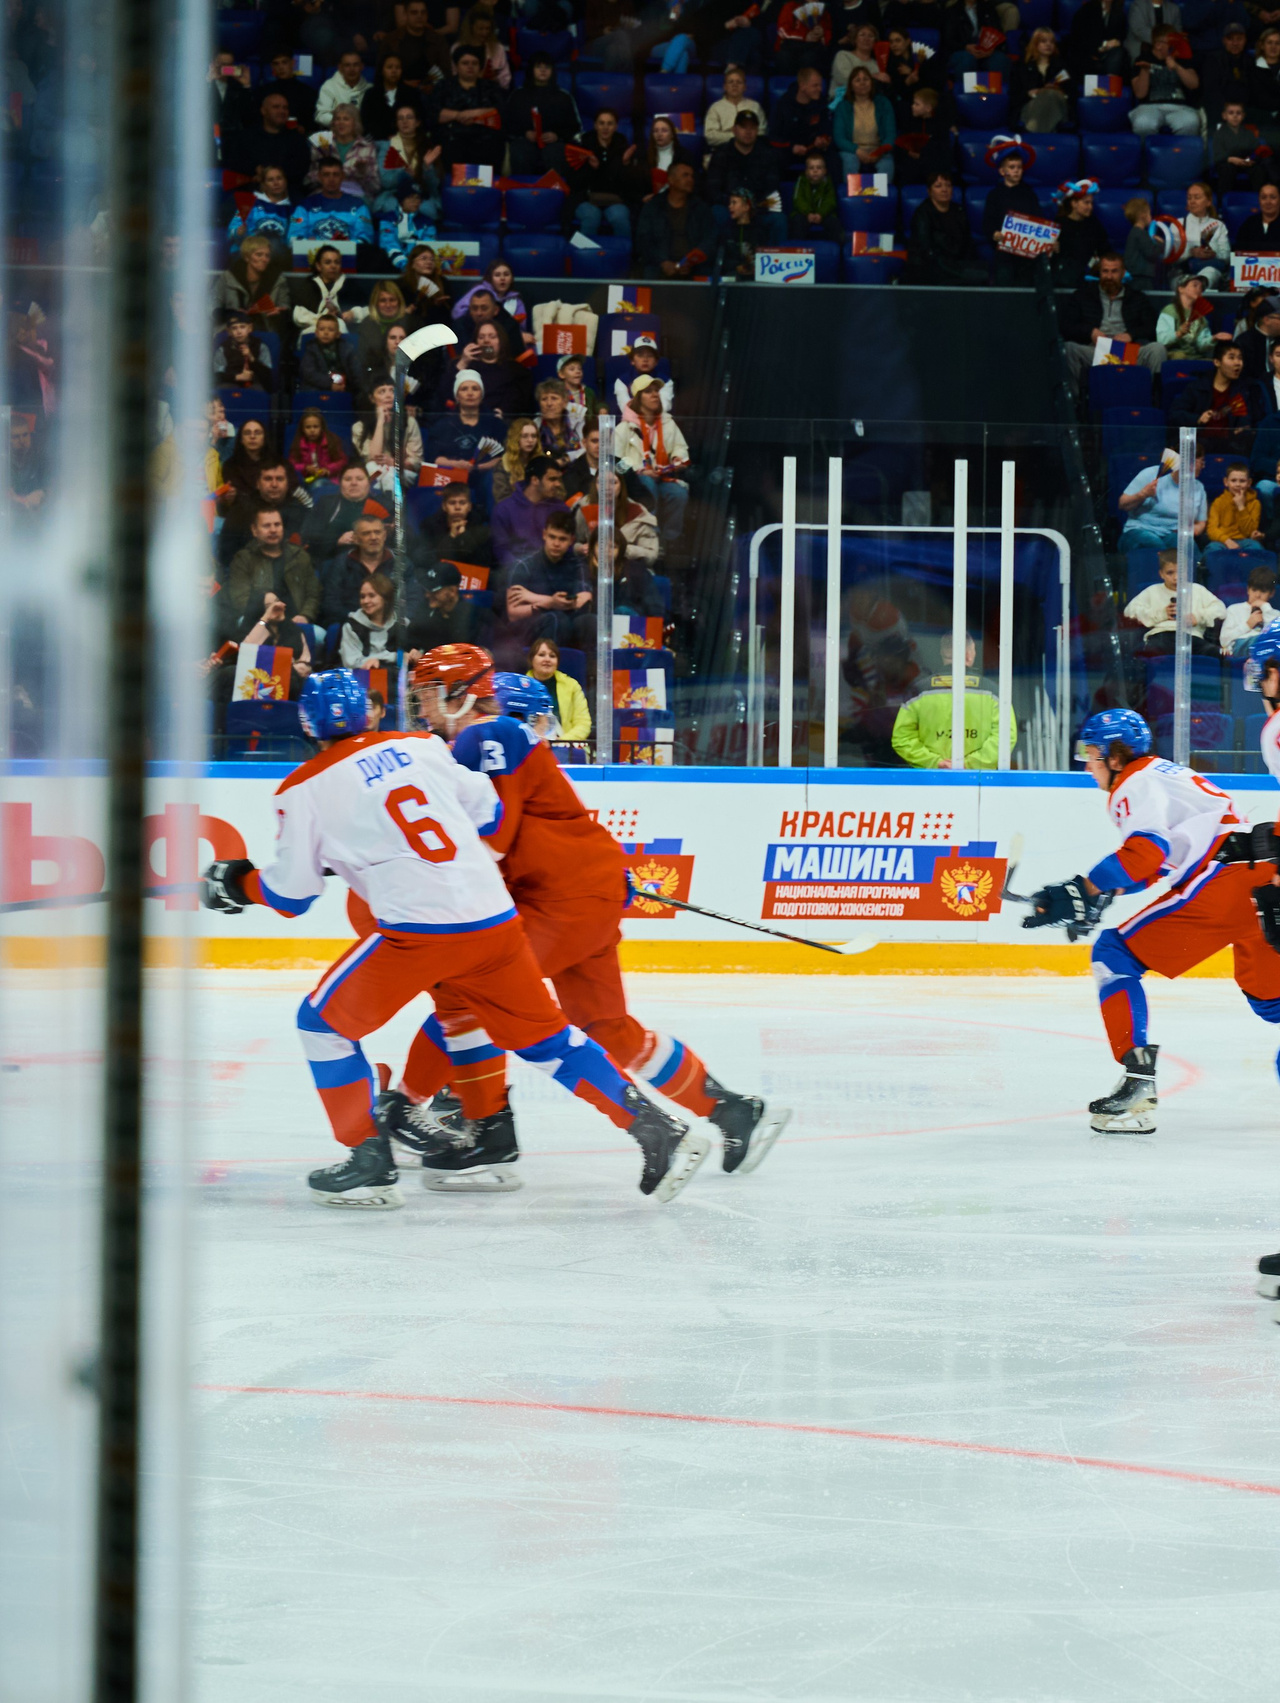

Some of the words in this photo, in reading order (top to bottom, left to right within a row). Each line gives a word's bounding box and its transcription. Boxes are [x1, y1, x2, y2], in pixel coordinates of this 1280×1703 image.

[355, 746, 414, 788] ДИЛЬ
[384, 783, 457, 864] 6
[779, 811, 914, 839] КРАСНАЯ
[772, 847, 915, 881] МАШИНА
[775, 885, 858, 899] НАЦИОНАЛЬНАЯ
[857, 886, 920, 899] ПРОГРАММА
[772, 902, 840, 917] ПОДГОТОВКИ
